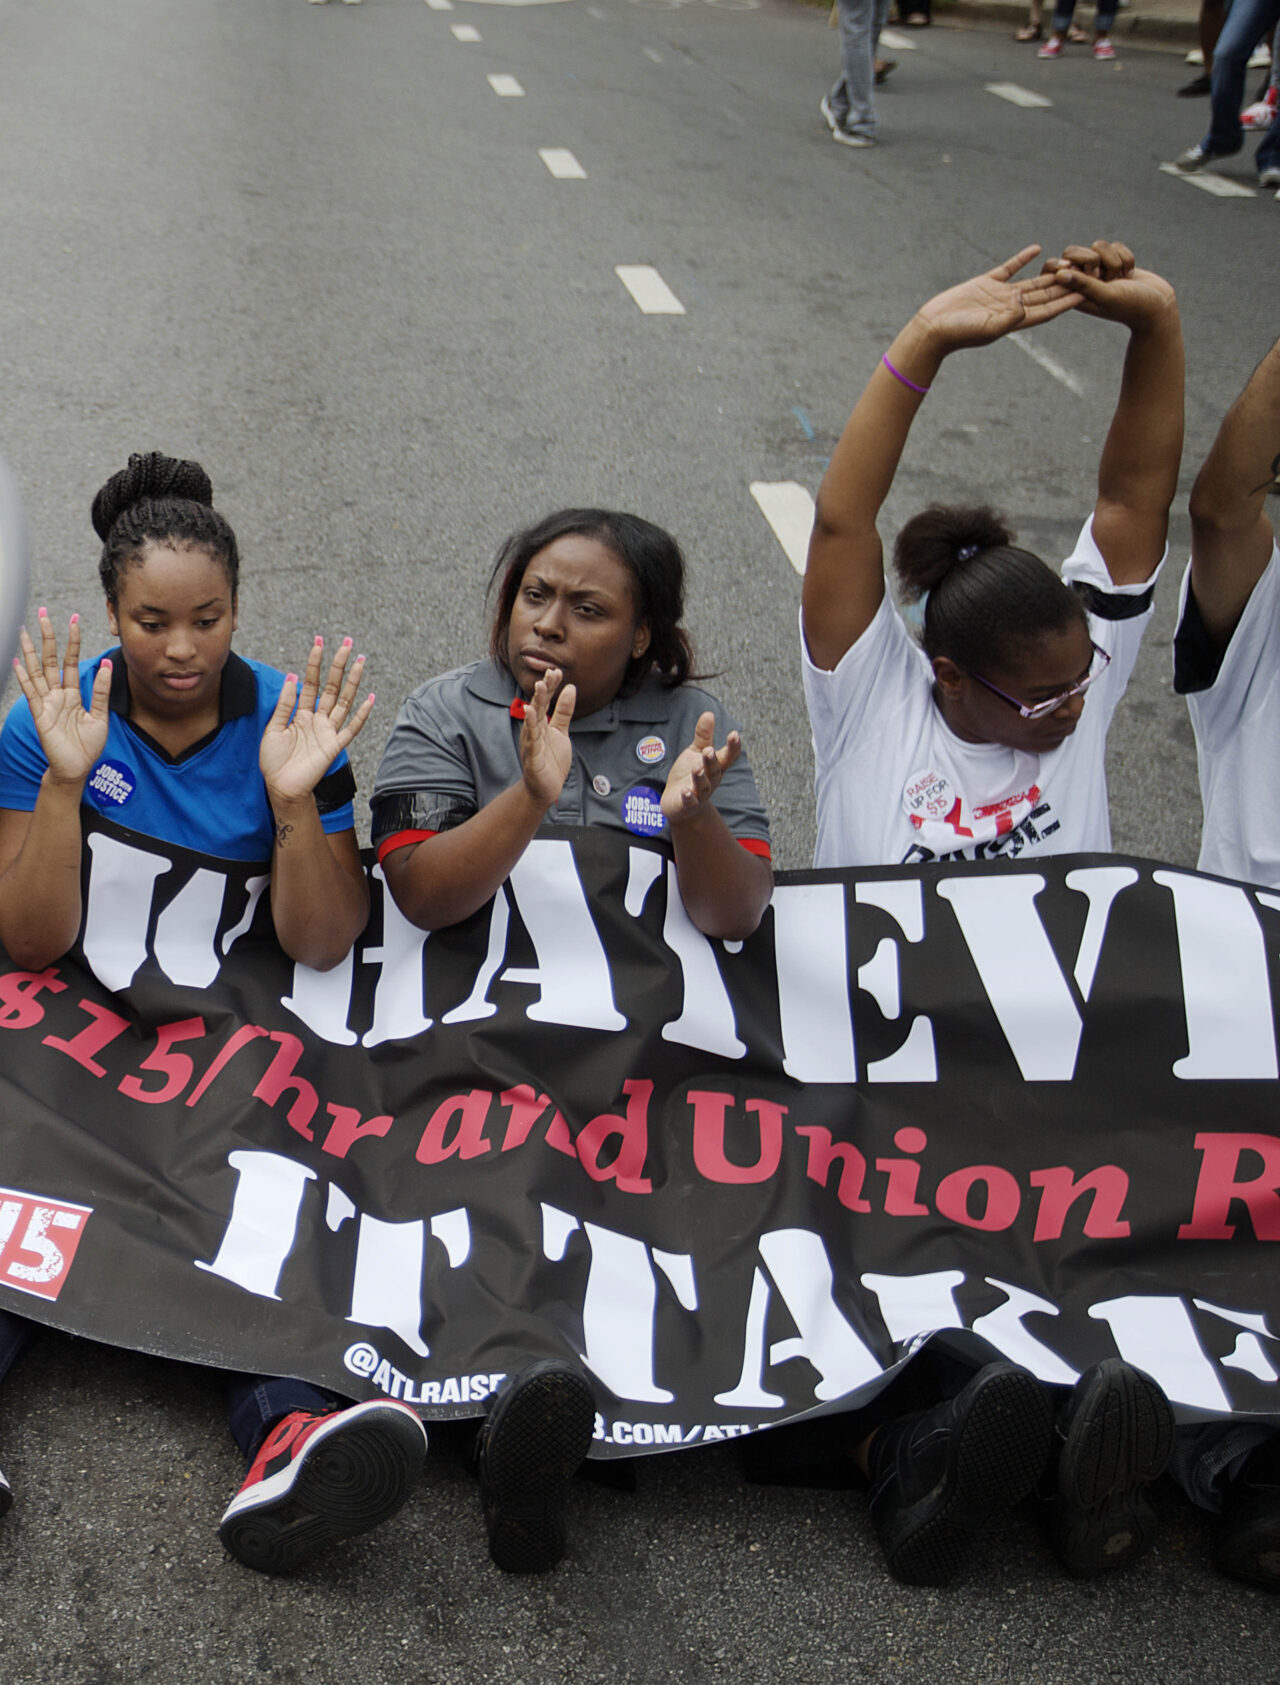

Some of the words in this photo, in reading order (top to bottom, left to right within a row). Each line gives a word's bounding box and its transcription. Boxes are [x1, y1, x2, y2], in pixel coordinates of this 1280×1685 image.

[96, 764, 123, 785] JOBS
[89, 776, 129, 804] JUSTICE
[625, 795, 650, 812] JOBS
[910, 795, 924, 809] UP
[925, 779, 949, 799] FOR
[625, 810, 663, 828] JUSTICE
[416, 1079, 653, 1194] and
[687, 1091, 1131, 1242] Union
[195, 1150, 472, 1358] IT
[541, 1202, 1280, 1412] TAKE
